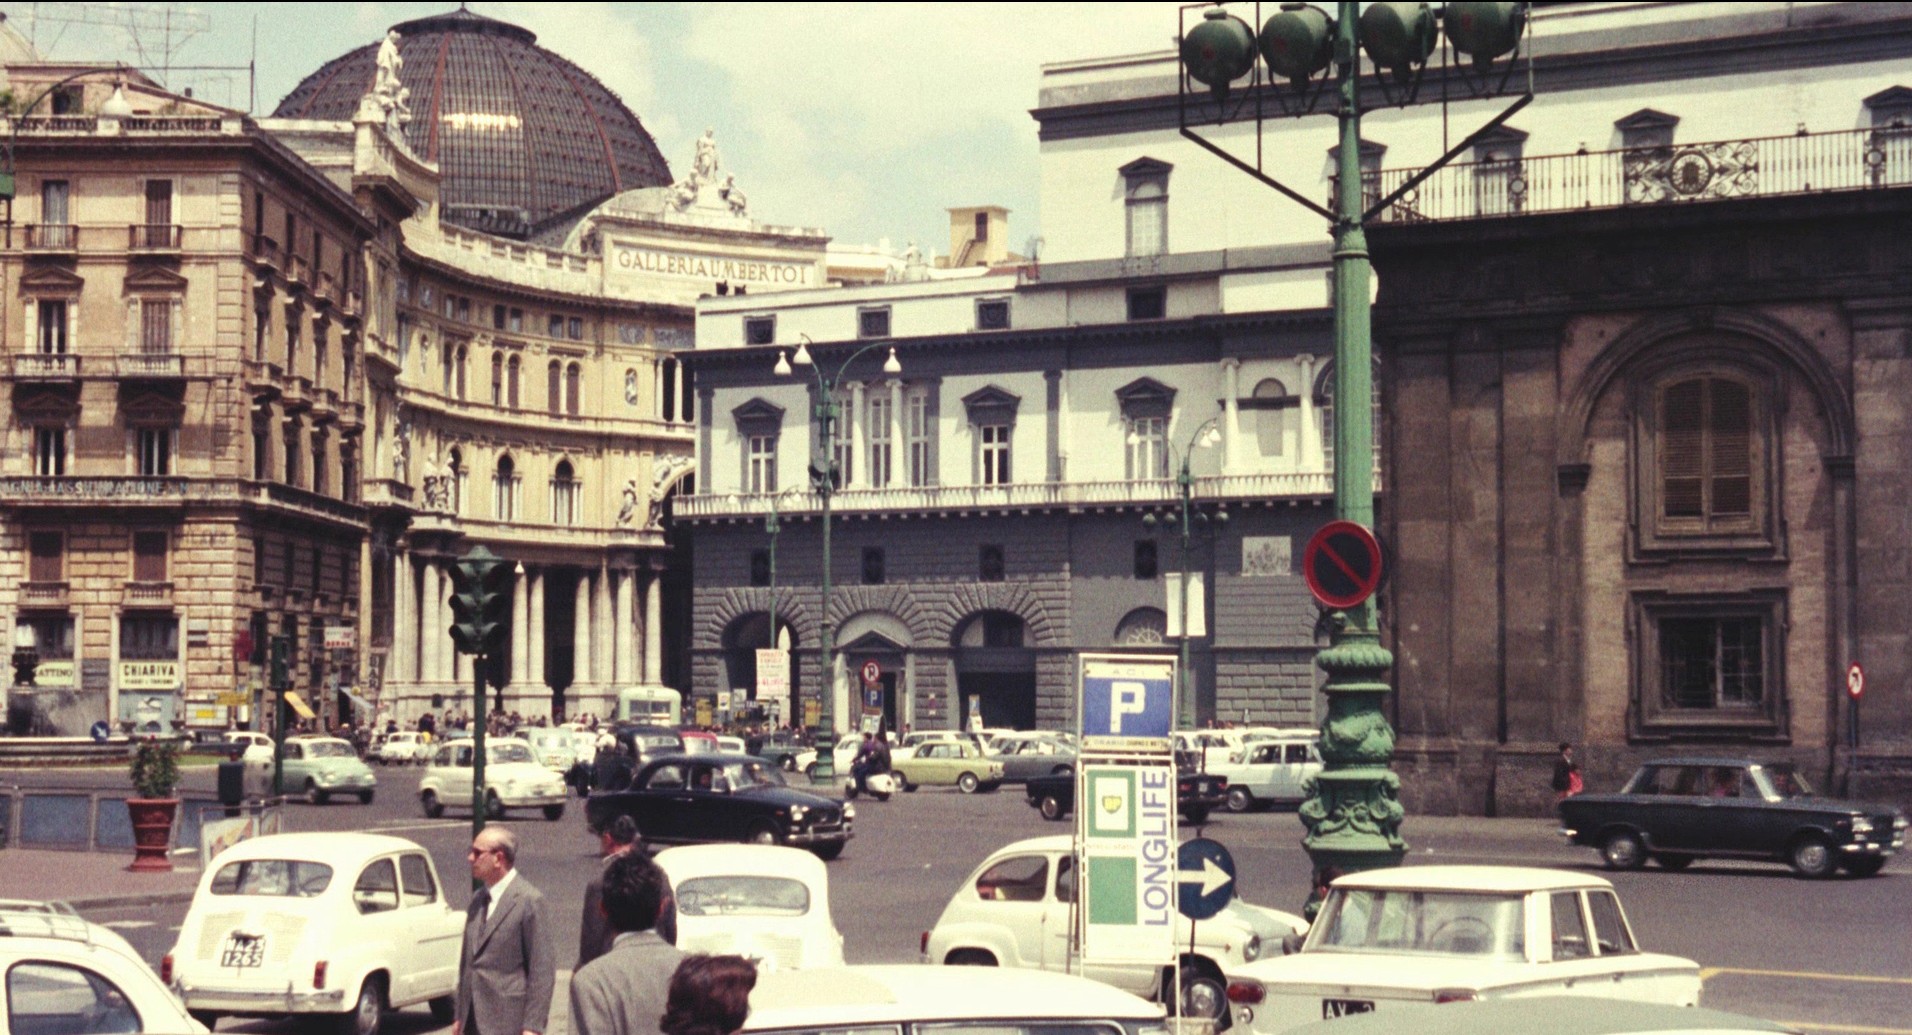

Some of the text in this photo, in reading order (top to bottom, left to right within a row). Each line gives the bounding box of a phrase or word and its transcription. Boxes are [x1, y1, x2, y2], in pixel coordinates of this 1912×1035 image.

[618, 250, 805, 284] GALLERIA UMBERTO I
[38, 668, 73, 678] ATTINO
[124, 664, 175, 676] CHIARIVA
[1110, 681, 1145, 733] P
[1142, 771, 1168, 926] LONGLIFE
[224, 952, 262, 966] 1265
